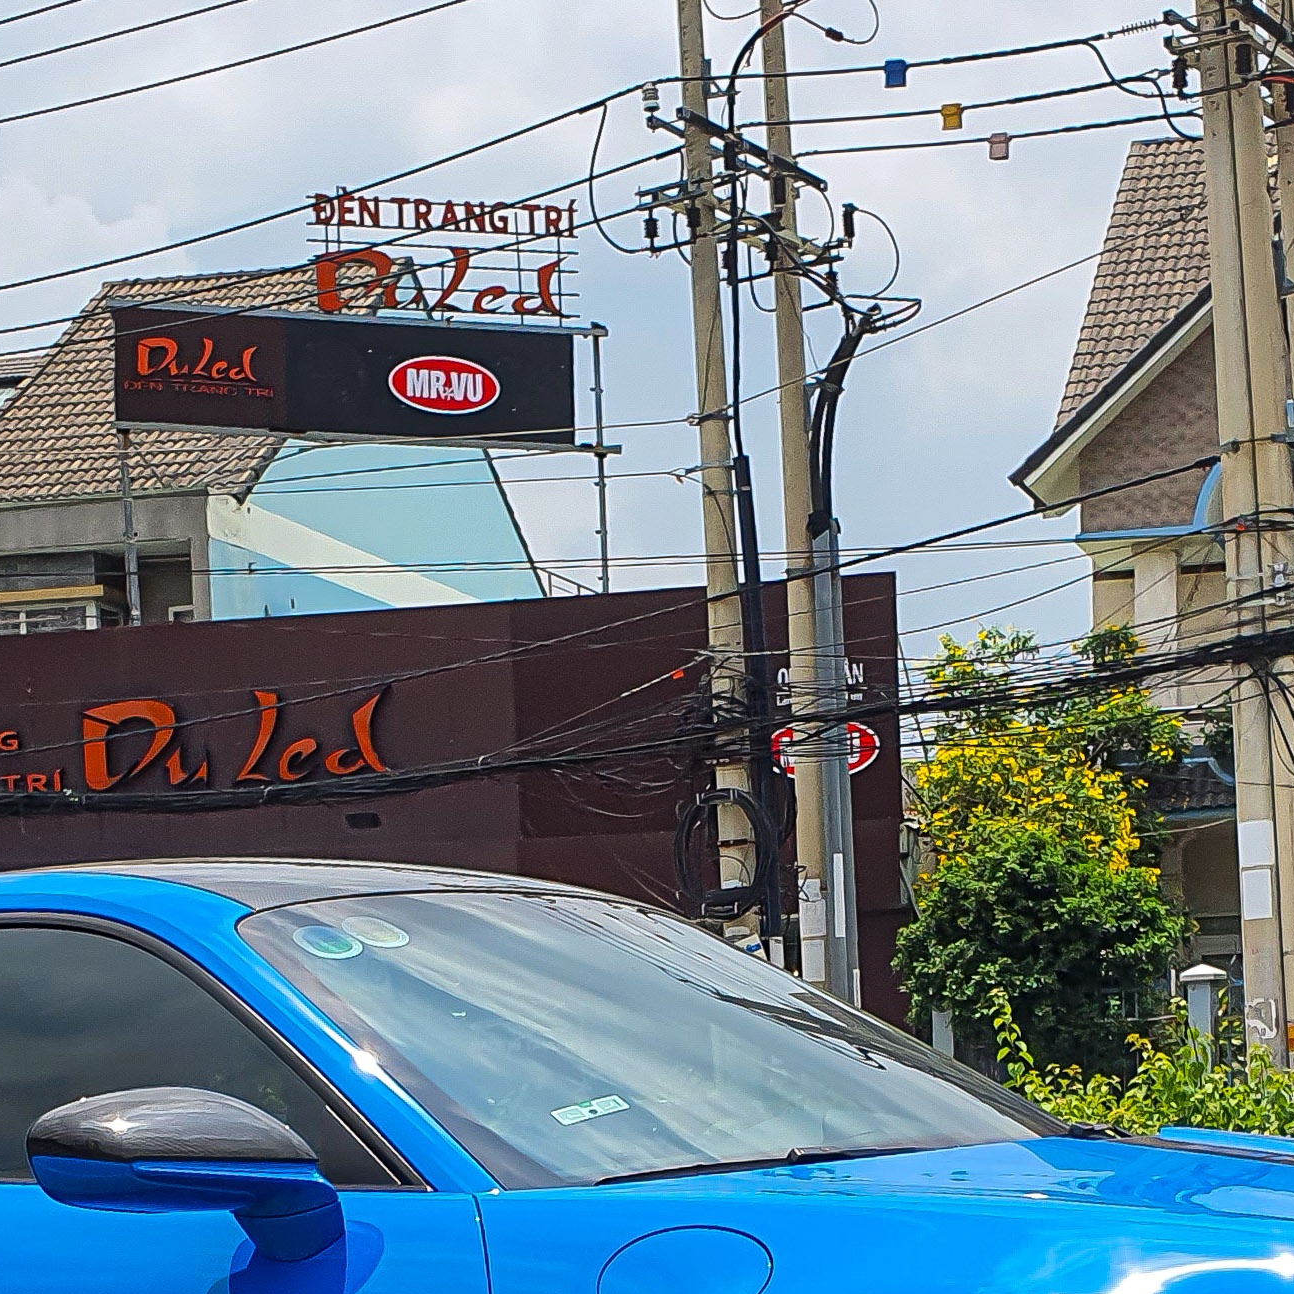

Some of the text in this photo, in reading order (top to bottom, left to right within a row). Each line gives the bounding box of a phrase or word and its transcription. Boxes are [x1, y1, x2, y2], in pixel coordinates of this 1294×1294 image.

[312, 187, 578, 237] ĐÈN TRANG TRÍ
[0, 768, 65, 793] TRÍ
